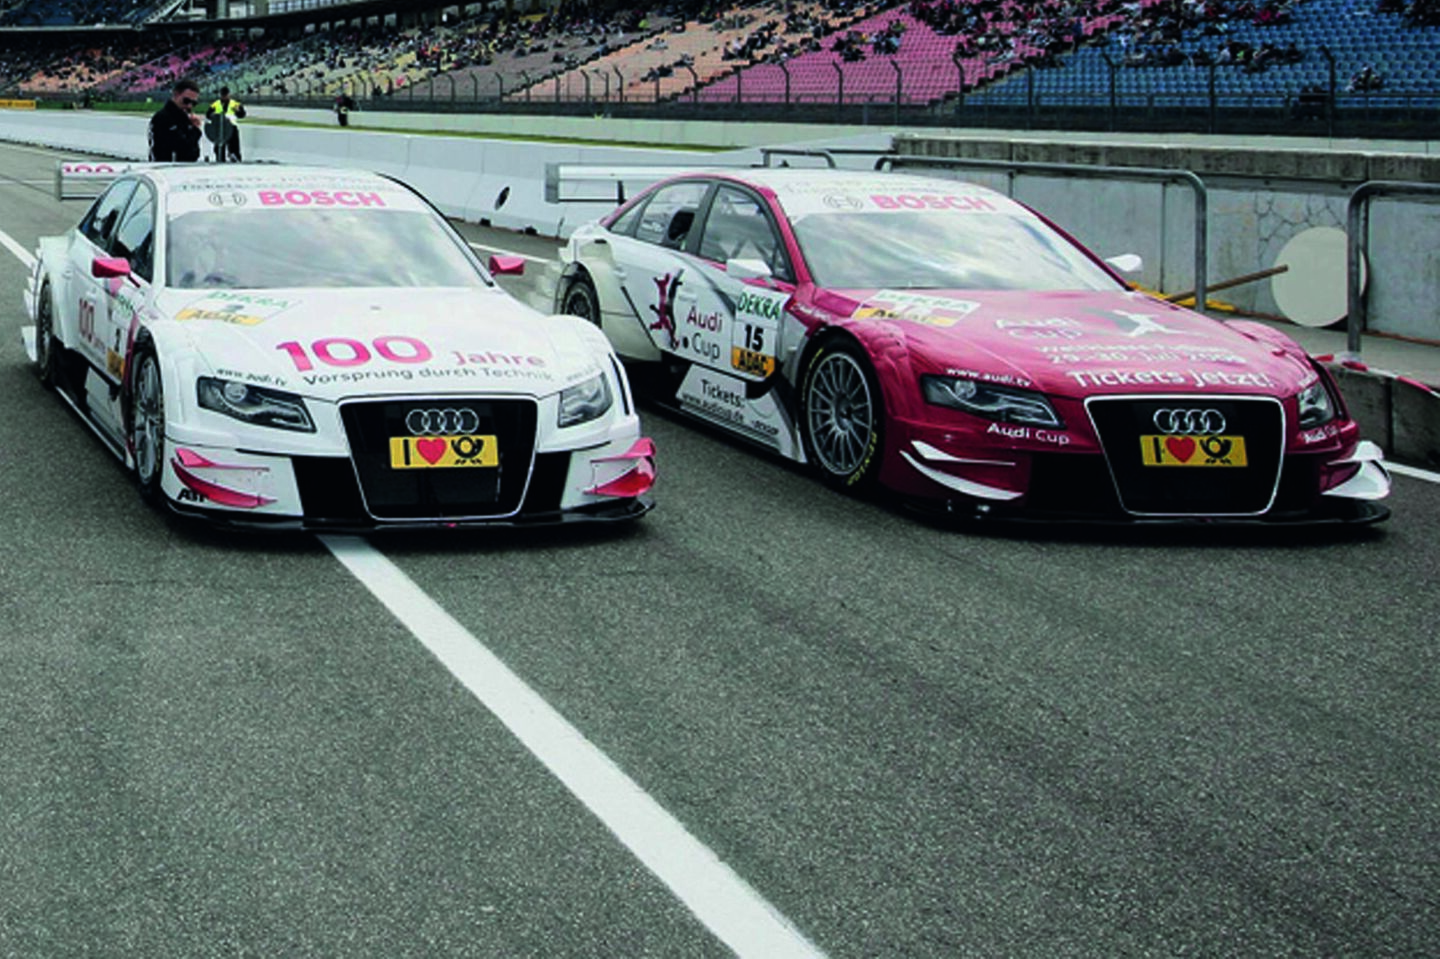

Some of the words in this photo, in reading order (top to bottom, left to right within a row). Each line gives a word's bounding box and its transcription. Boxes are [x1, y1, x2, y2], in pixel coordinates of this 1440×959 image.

[257, 190, 386, 207] BOSCH
[869, 194, 997, 211] BOSCH
[737, 291, 782, 321] DEKRA
[686, 305, 724, 333] Audi
[691, 332, 721, 363] Cup
[745, 324, 765, 352] 15
[275, 335, 433, 373] 100
[453, 350, 546, 368] Jahre
[302, 367, 414, 387] Vorsprung
[417, 366, 477, 378] durch
[481, 366, 554, 382] Technik
[946, 367, 1033, 388] www.audi.tv
[1066, 369, 1186, 388] Tickets
[1189, 370, 1278, 389] jetzt!
[986, 422, 1030, 439] Audi
[1035, 429, 1070, 445] Cup
